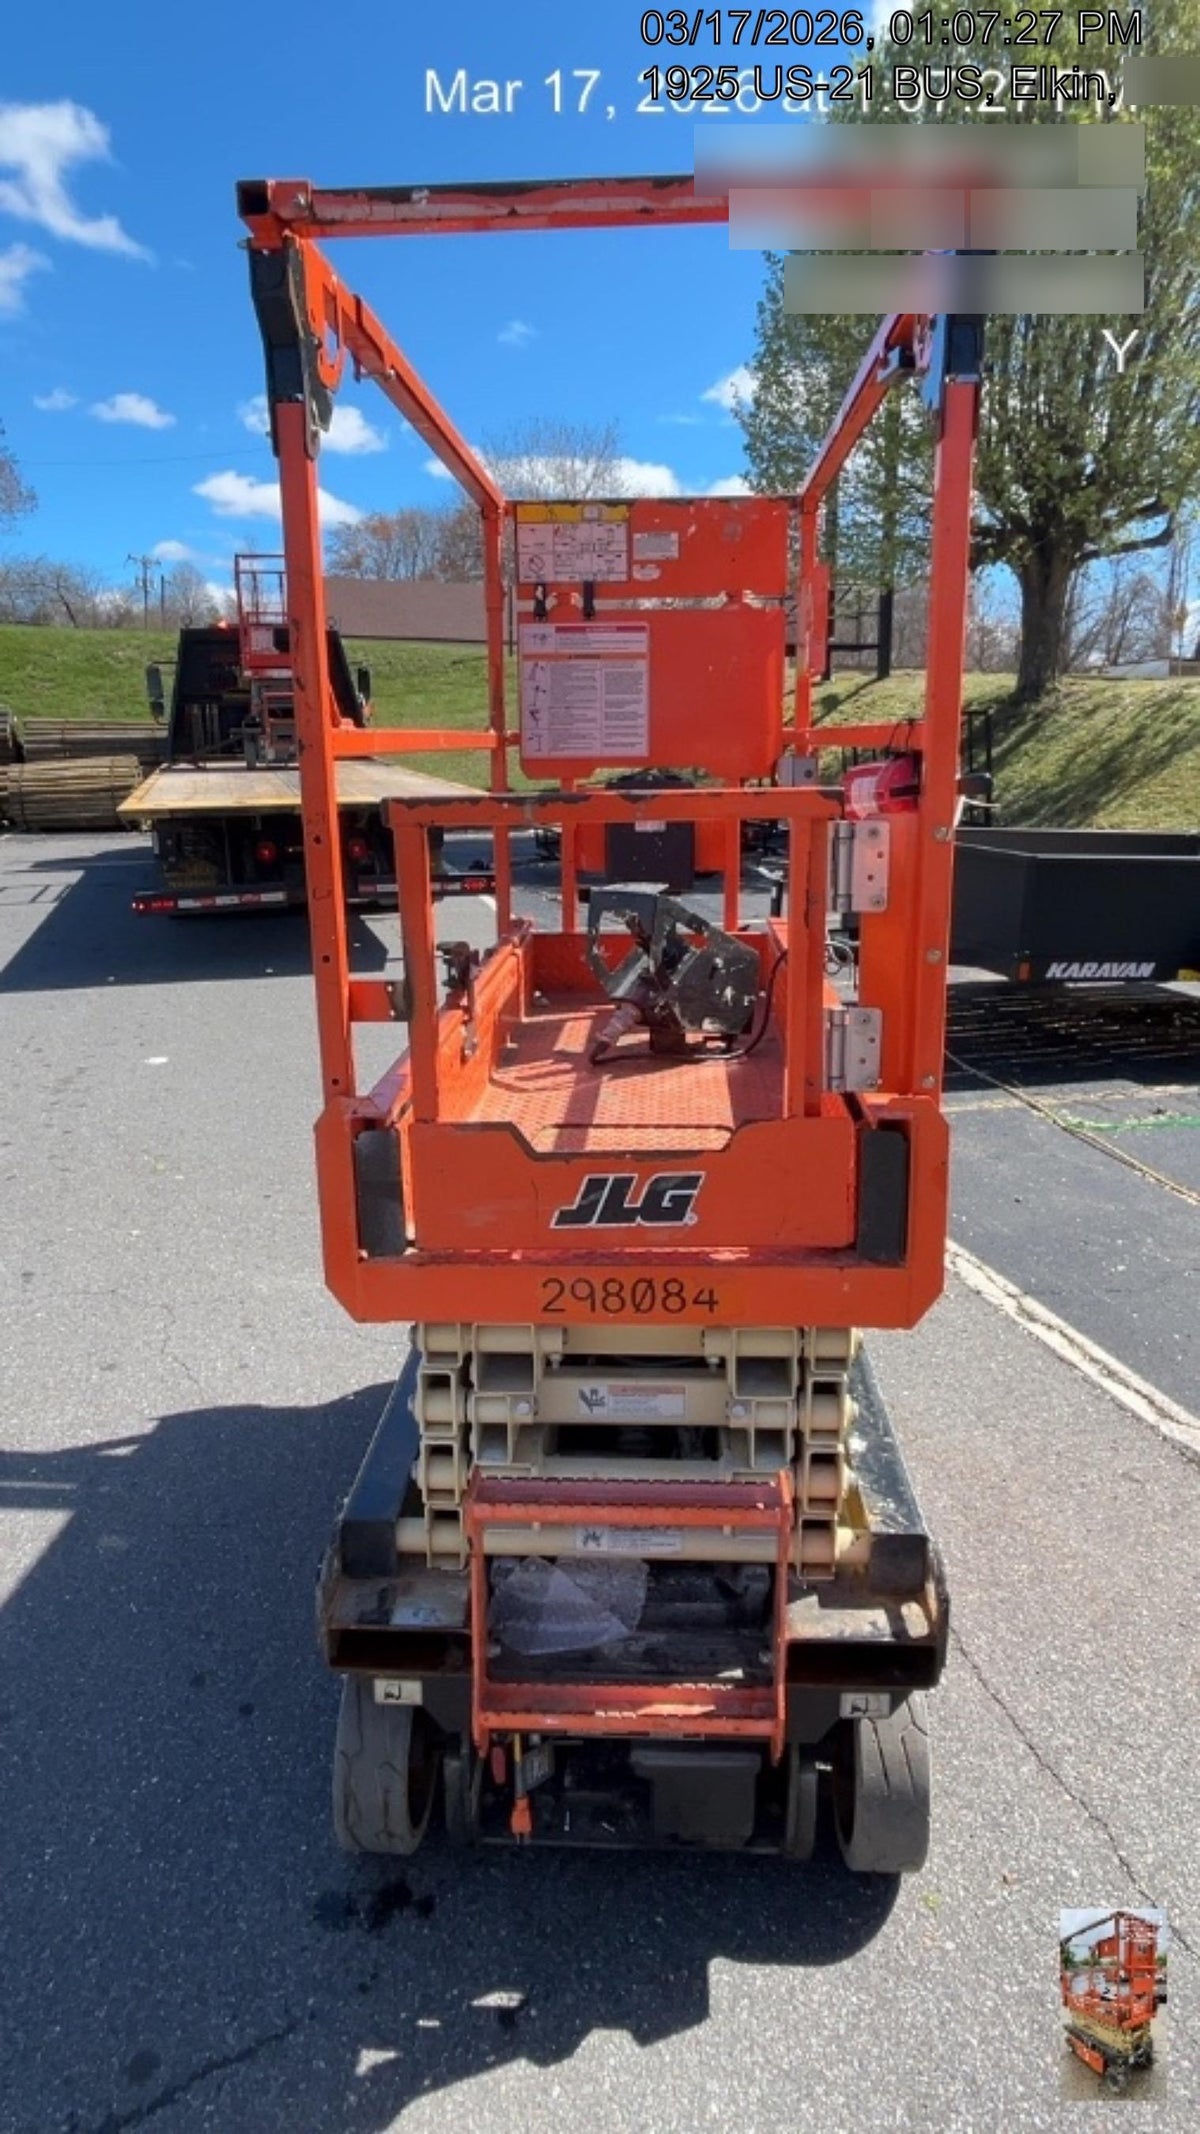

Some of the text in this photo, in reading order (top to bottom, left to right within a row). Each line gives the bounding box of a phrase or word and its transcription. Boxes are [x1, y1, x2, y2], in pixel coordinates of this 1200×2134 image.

[1046, 962, 1156, 979] KARAVAN
[549, 1171, 706, 1229] JLG
[541, 1277, 719, 1314] 298084
